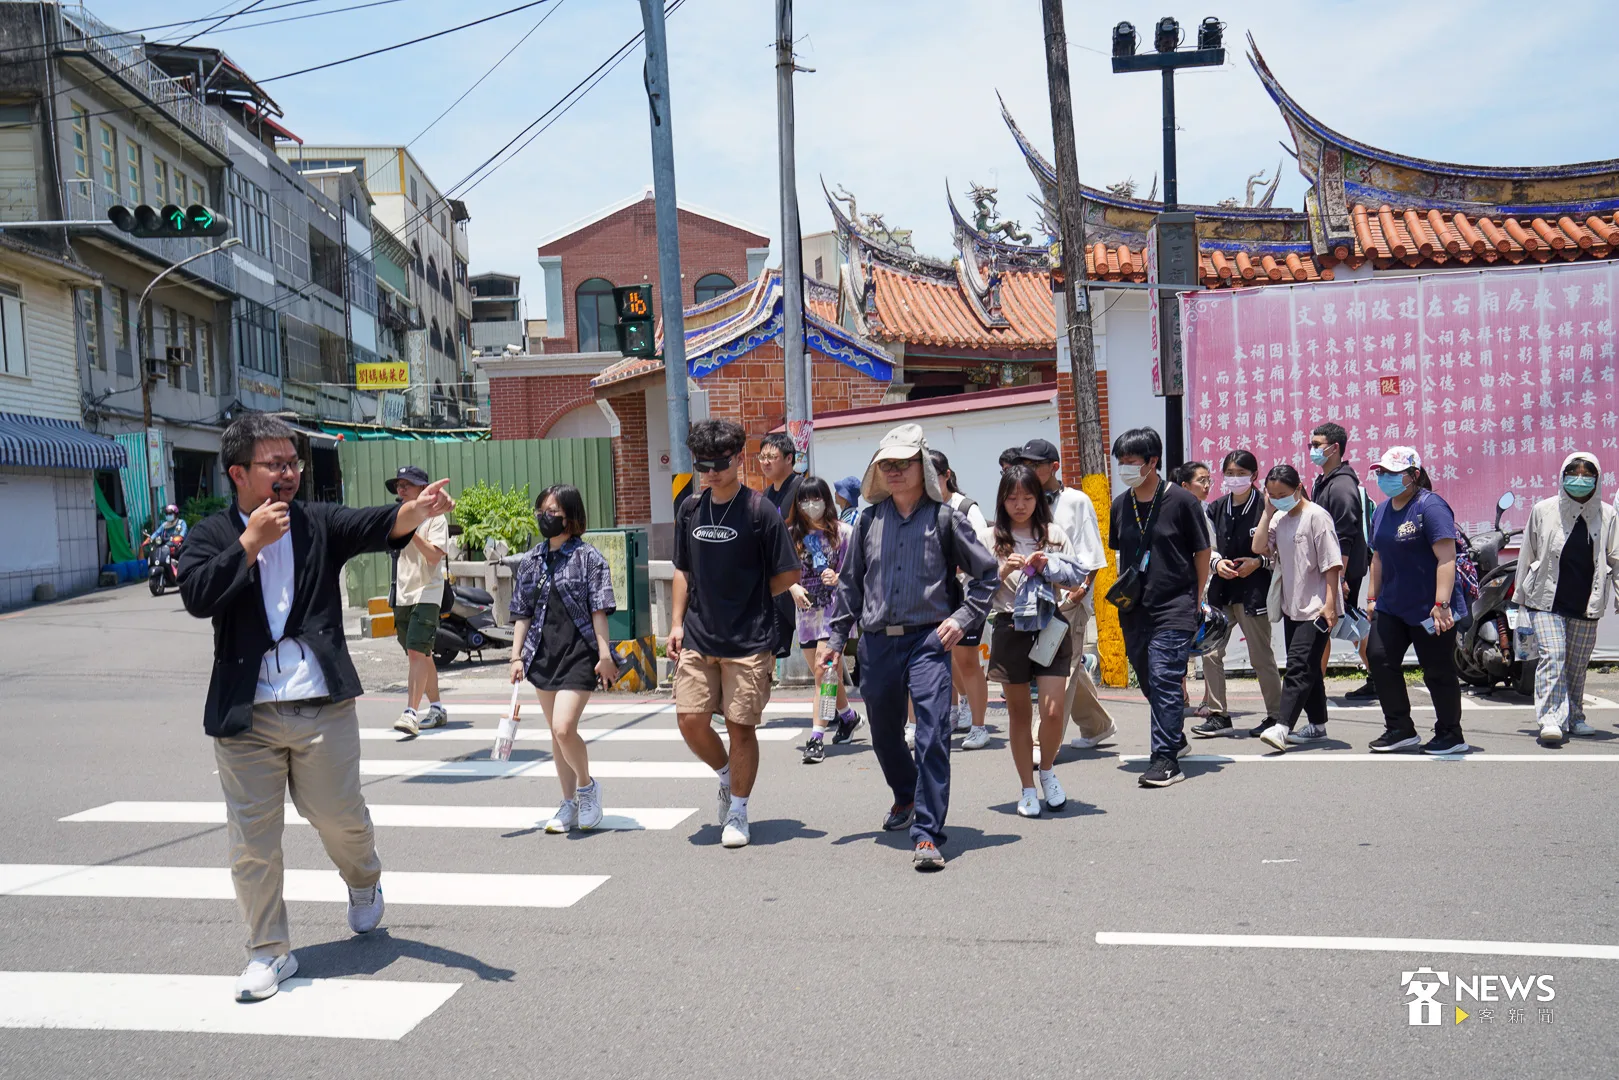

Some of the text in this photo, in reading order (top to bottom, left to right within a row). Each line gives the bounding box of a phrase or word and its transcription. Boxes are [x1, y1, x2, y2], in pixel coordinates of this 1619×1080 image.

[358, 368, 407, 384] 劉媽媽菜包
